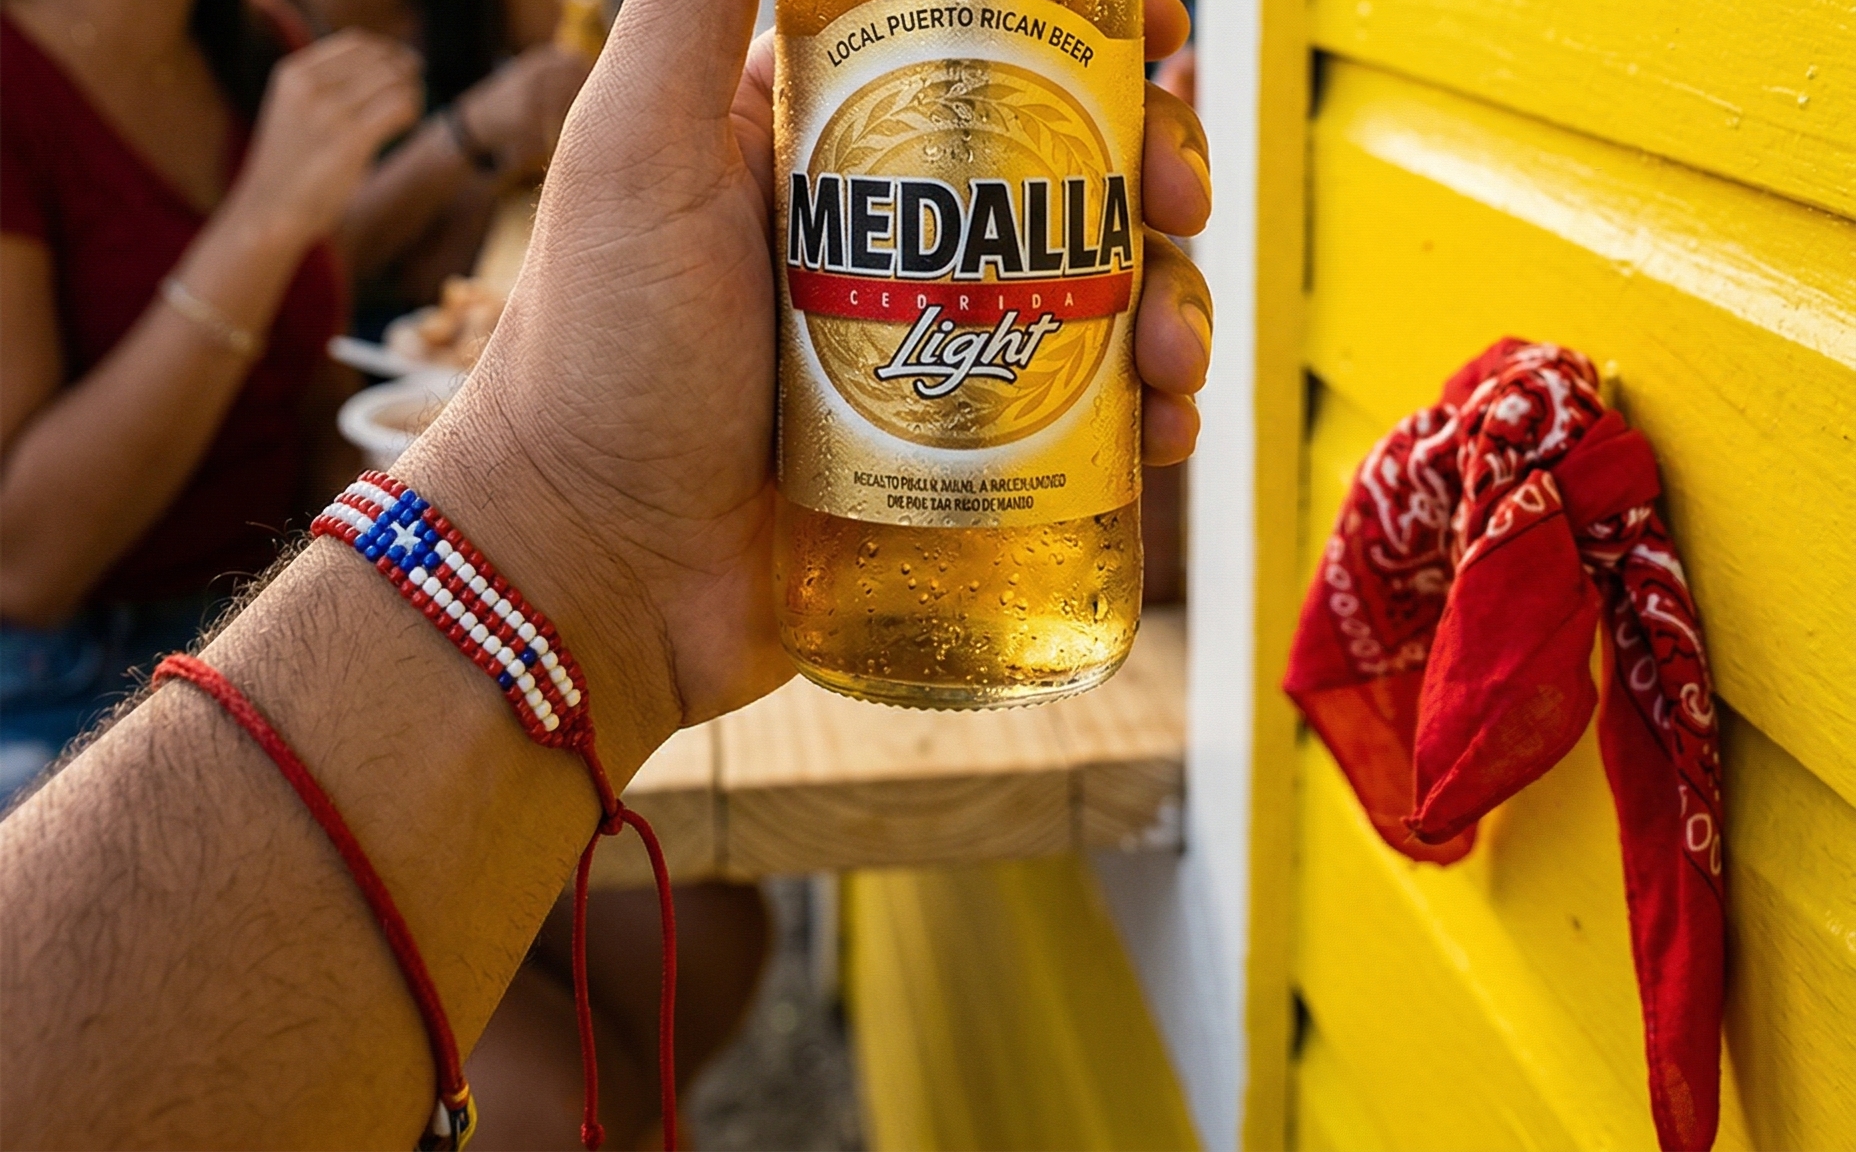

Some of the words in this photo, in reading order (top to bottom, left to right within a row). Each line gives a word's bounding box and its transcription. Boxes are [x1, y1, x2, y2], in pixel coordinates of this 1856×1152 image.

[827, 23, 885, 67] LOCAL
[887, 6, 974, 38] PUERTO
[980, 9, 1049, 41] RICAN
[1049, 27, 1095, 68] BEER
[787, 173, 1134, 280] MEDALLA
[850, 289, 1074, 311] CEDRIDA
[875, 305, 1063, 398] Light
